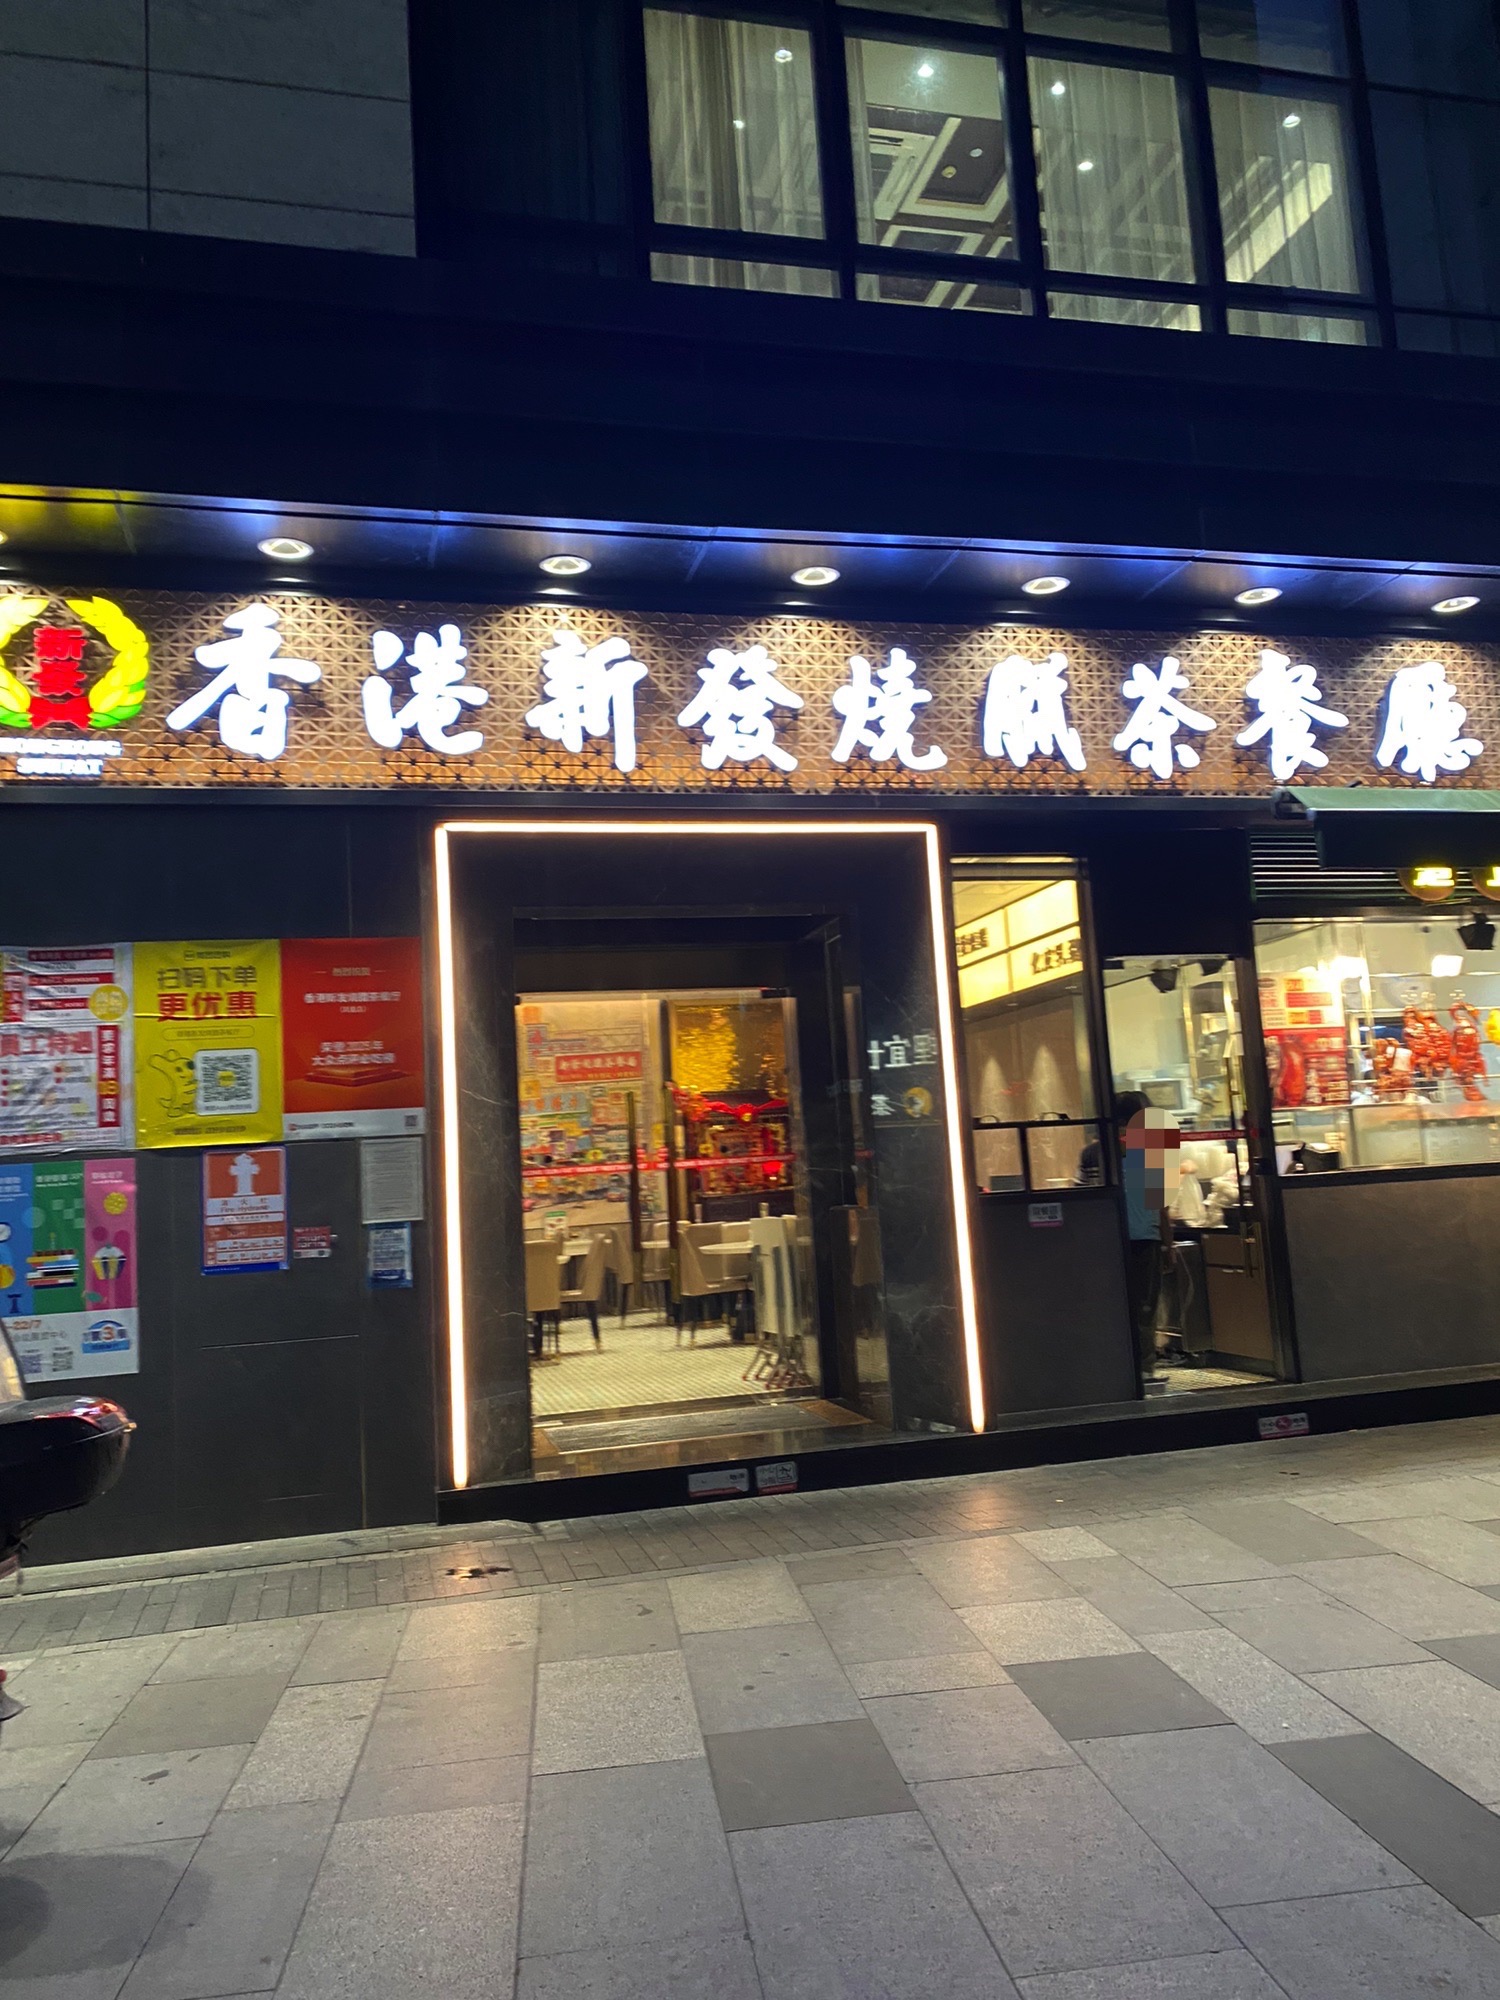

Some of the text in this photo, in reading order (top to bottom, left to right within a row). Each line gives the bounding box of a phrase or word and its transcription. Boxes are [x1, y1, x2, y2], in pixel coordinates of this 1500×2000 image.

[157, 966, 257, 989] 扫码下单
[157, 991, 257, 1022] 更优惠
